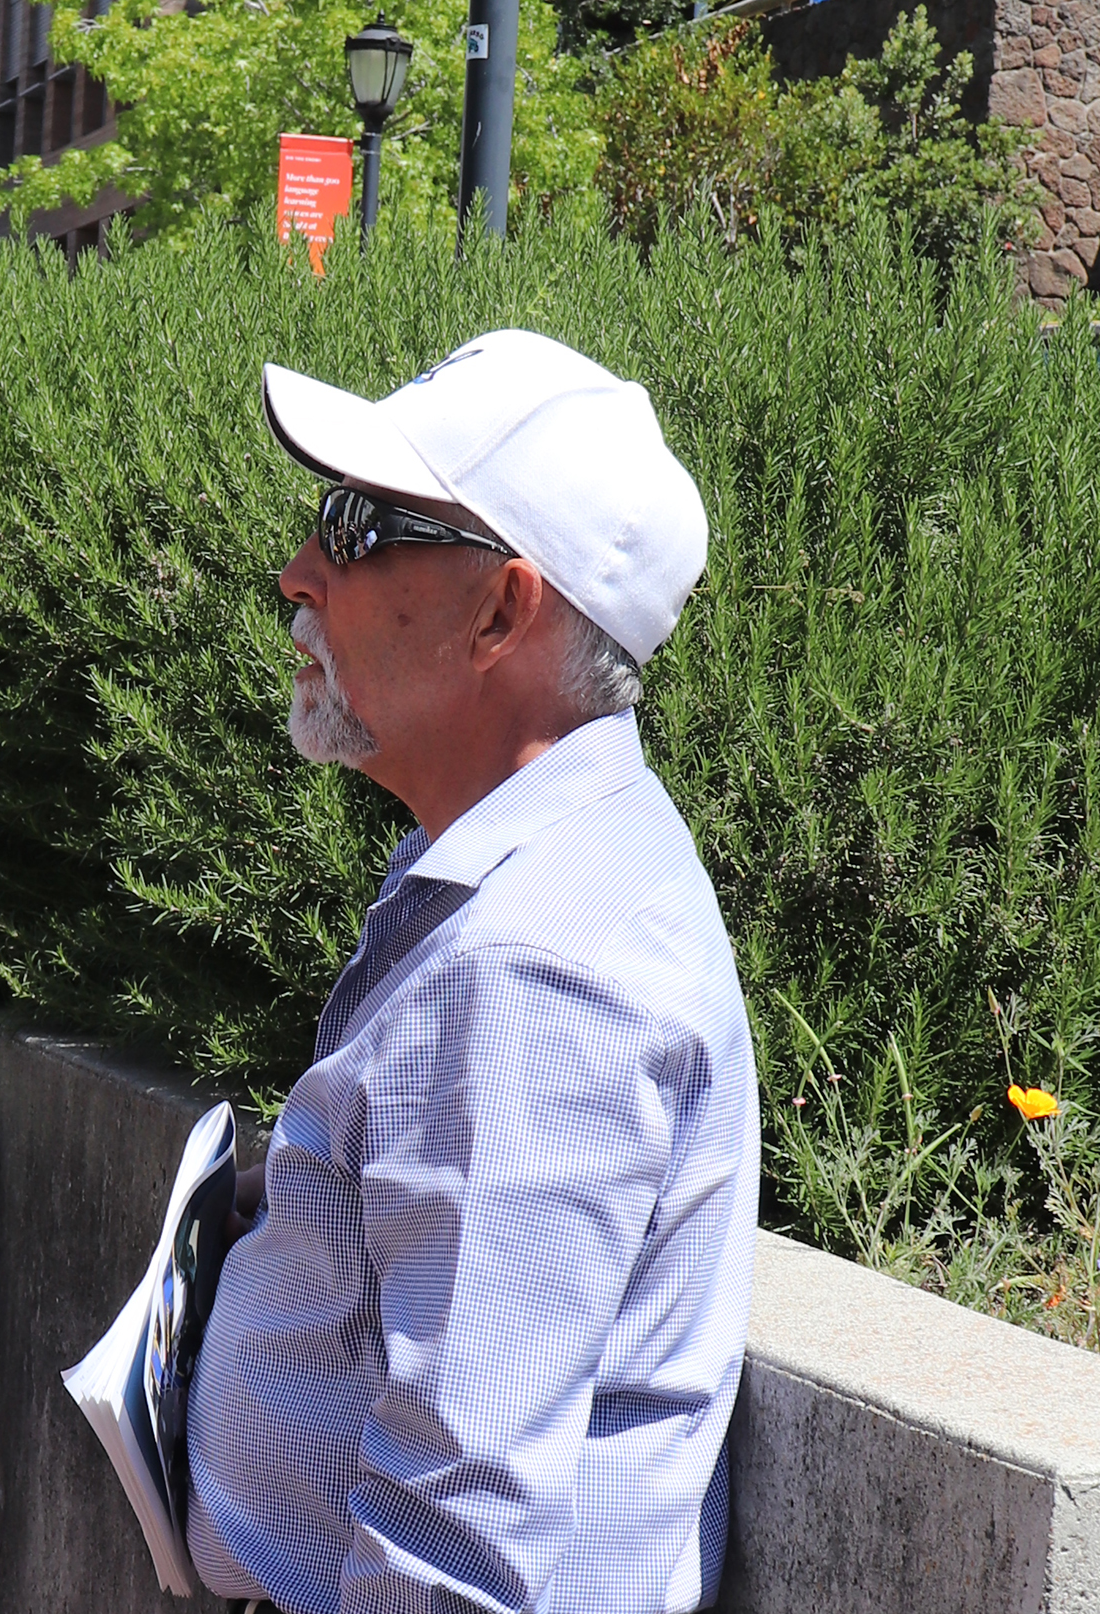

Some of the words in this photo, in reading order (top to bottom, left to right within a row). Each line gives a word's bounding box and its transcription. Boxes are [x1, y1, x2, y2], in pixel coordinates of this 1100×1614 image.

[285, 172, 304, 182] More
[305, 173, 324, 183] than
[284, 185, 319, 197] language
[284, 196, 317, 208] learning
